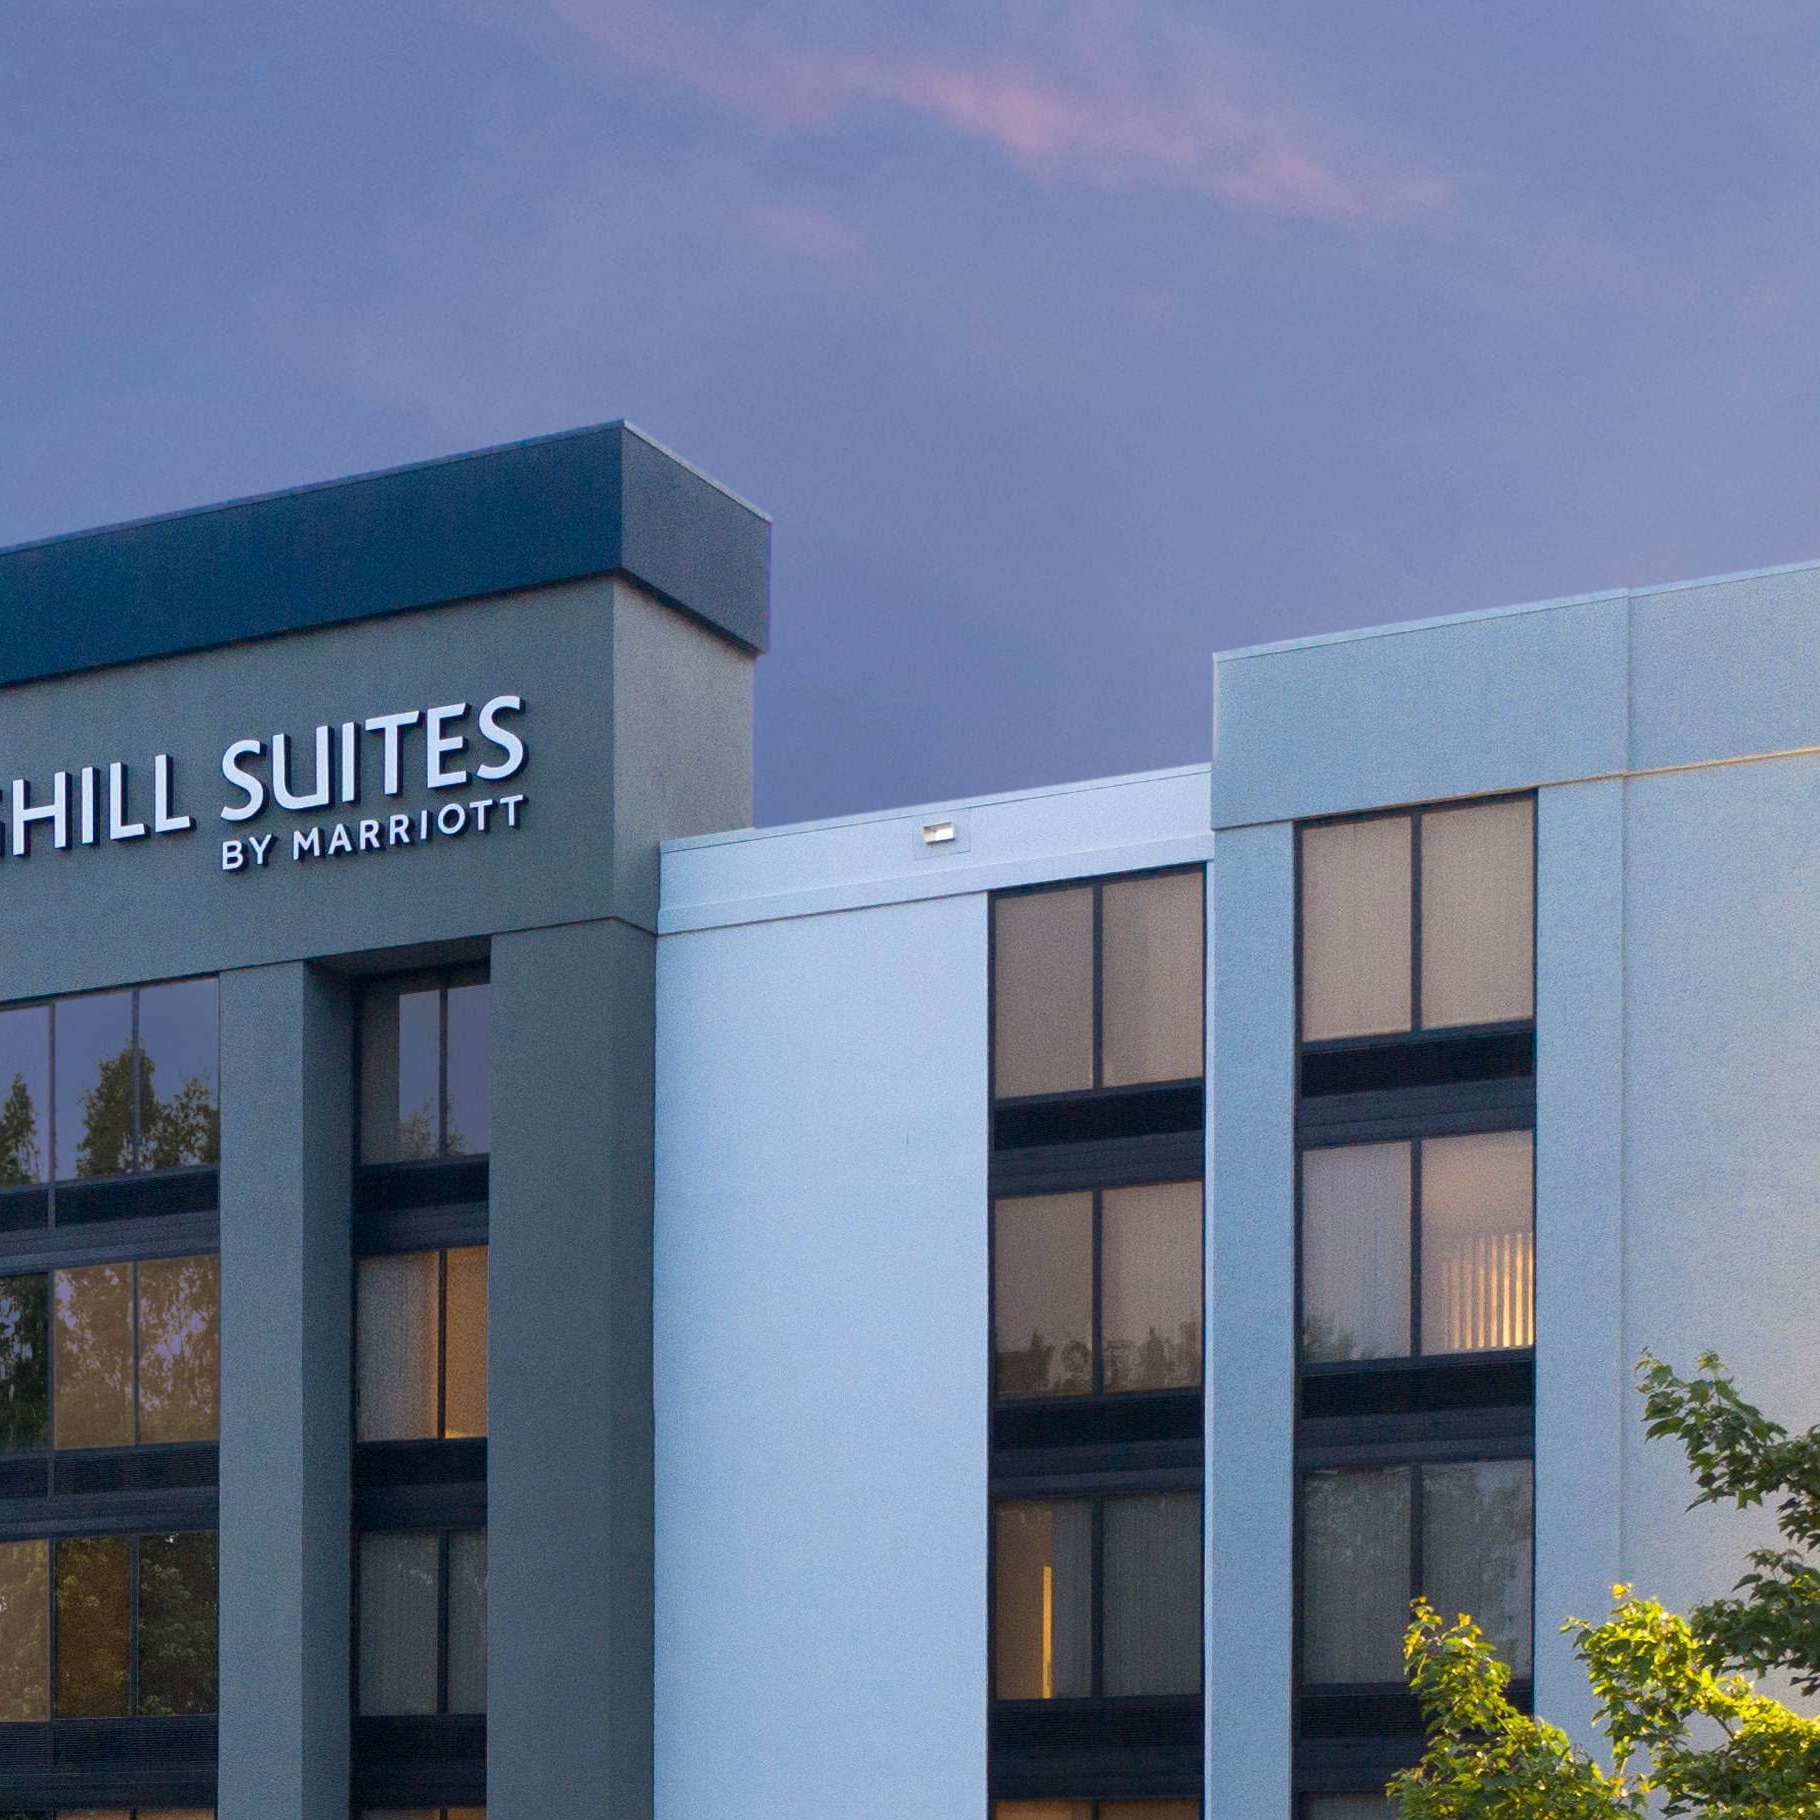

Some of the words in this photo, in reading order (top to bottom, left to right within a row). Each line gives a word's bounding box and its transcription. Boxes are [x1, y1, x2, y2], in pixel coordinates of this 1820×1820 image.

[220, 695, 524, 821] SUITES
[221, 834, 272, 871] BY
[293, 794, 524, 860] MARRIOTT
